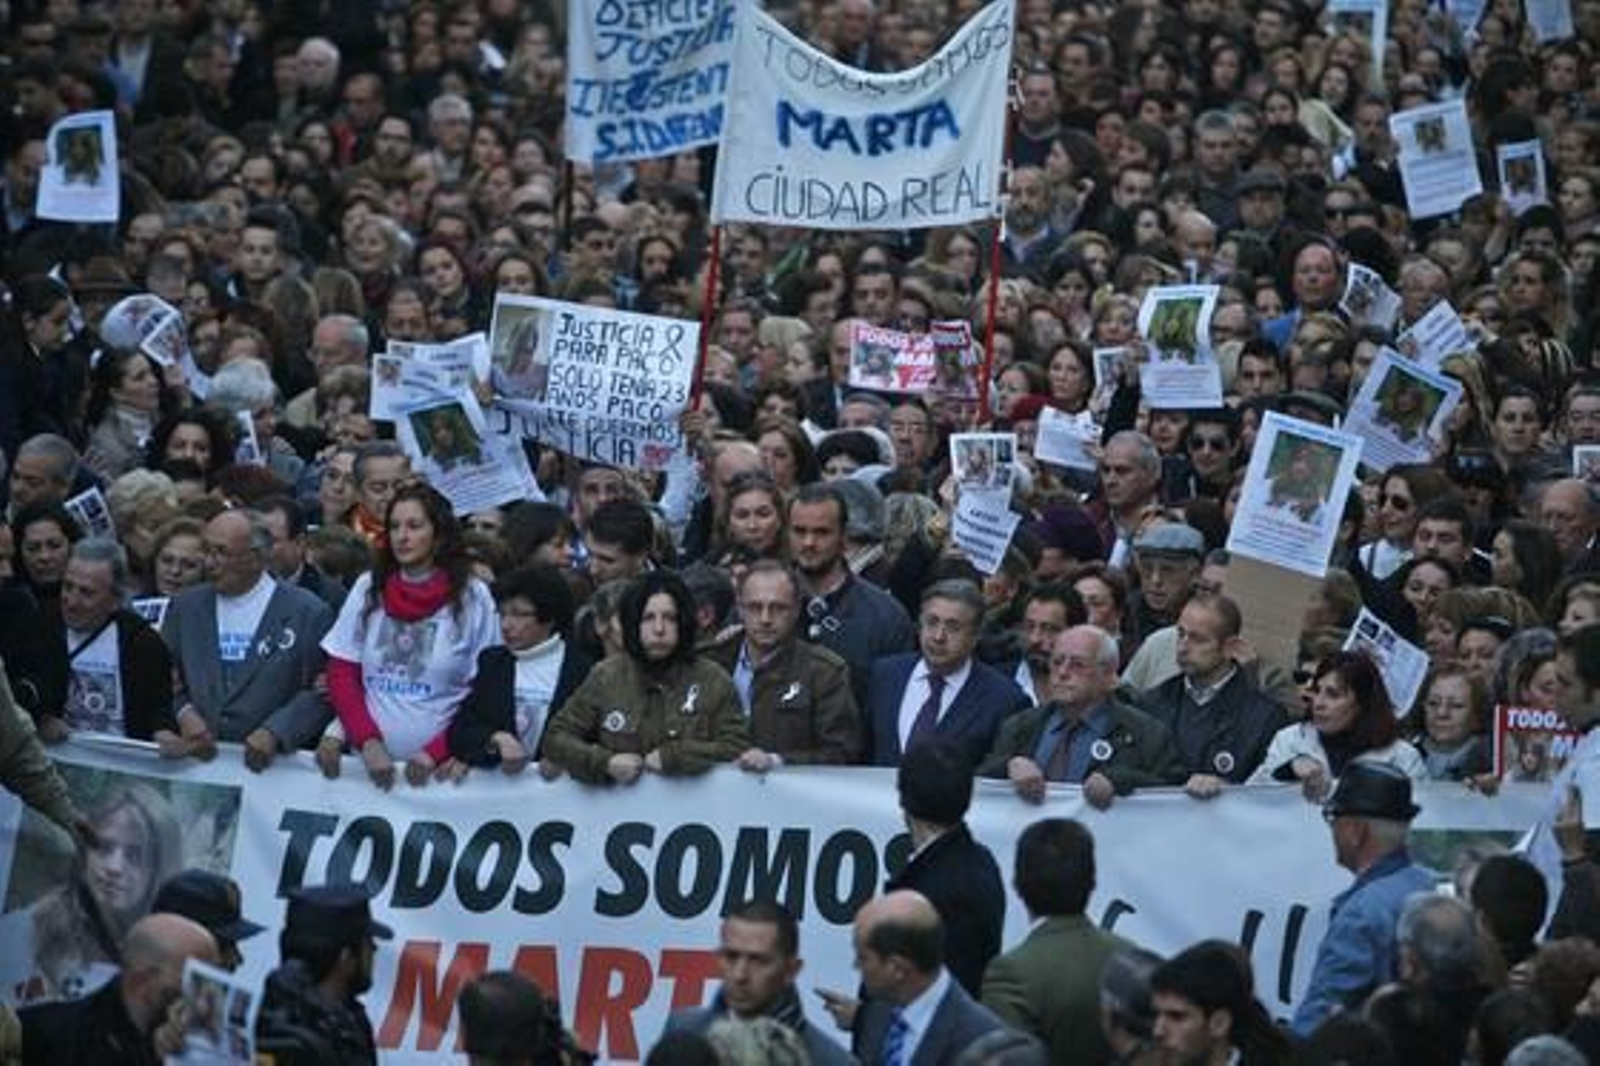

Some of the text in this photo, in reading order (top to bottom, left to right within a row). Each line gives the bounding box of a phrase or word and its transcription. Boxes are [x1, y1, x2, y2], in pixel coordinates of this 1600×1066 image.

[776, 98, 961, 156] MARTA
[901, 159, 991, 219] REAL
[557, 312, 655, 347] JUSTICIA
[552, 338, 675, 377] PARA PACO
[550, 364, 604, 392] SOLO
[659, 381, 687, 403] 23
[606, 395, 663, 423] PACO
[275, 808, 576, 915] TODOS
